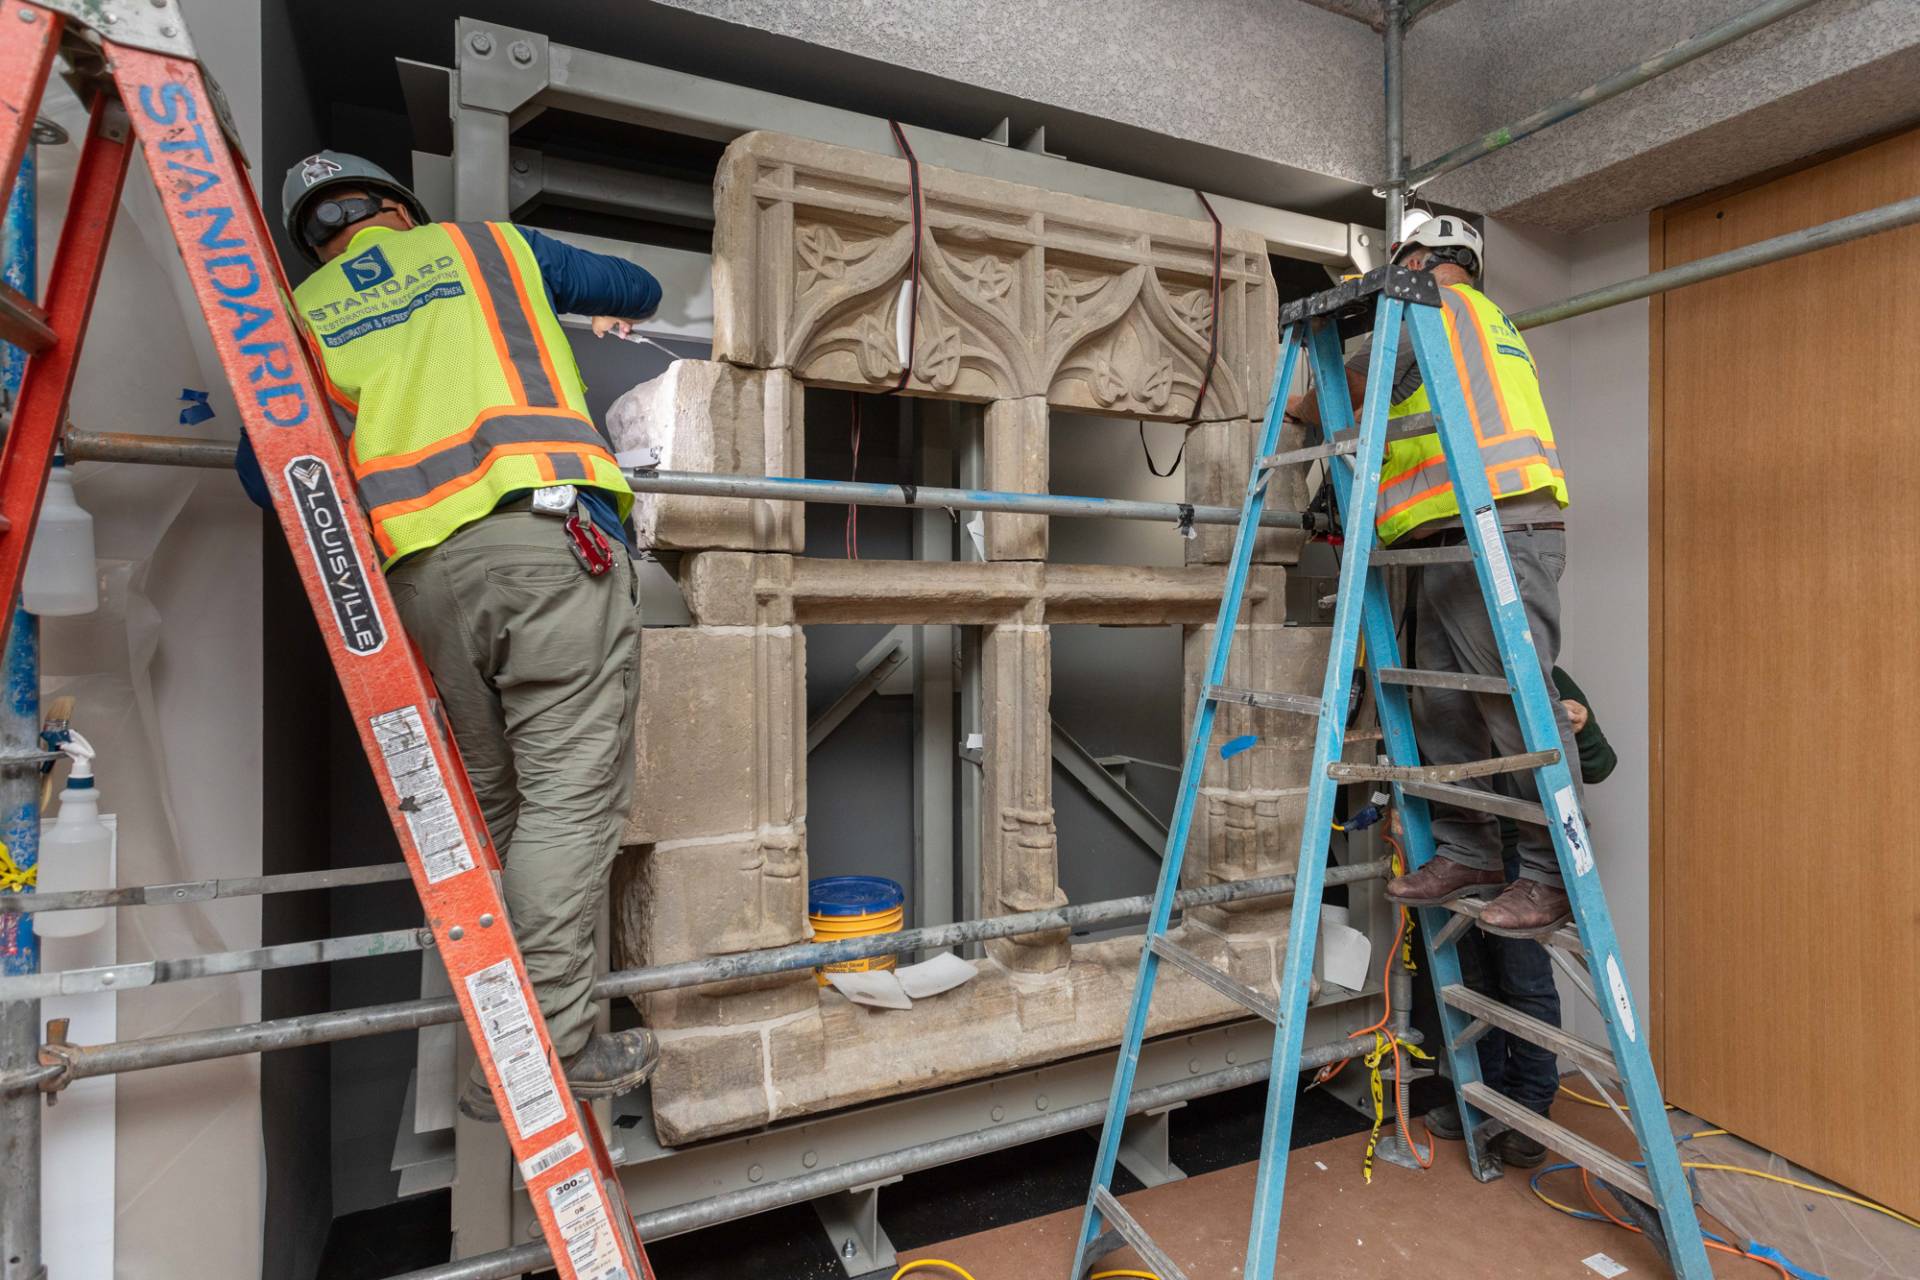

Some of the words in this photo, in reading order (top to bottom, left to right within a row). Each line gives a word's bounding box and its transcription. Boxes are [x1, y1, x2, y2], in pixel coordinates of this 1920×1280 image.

[138, 82, 309, 427] STANDARD
[351, 253, 382, 285] S
[308, 255, 454, 321] STANDARD
[307, 491, 375, 650] LOUISVILLE
[555, 1179, 578, 1196] 300
